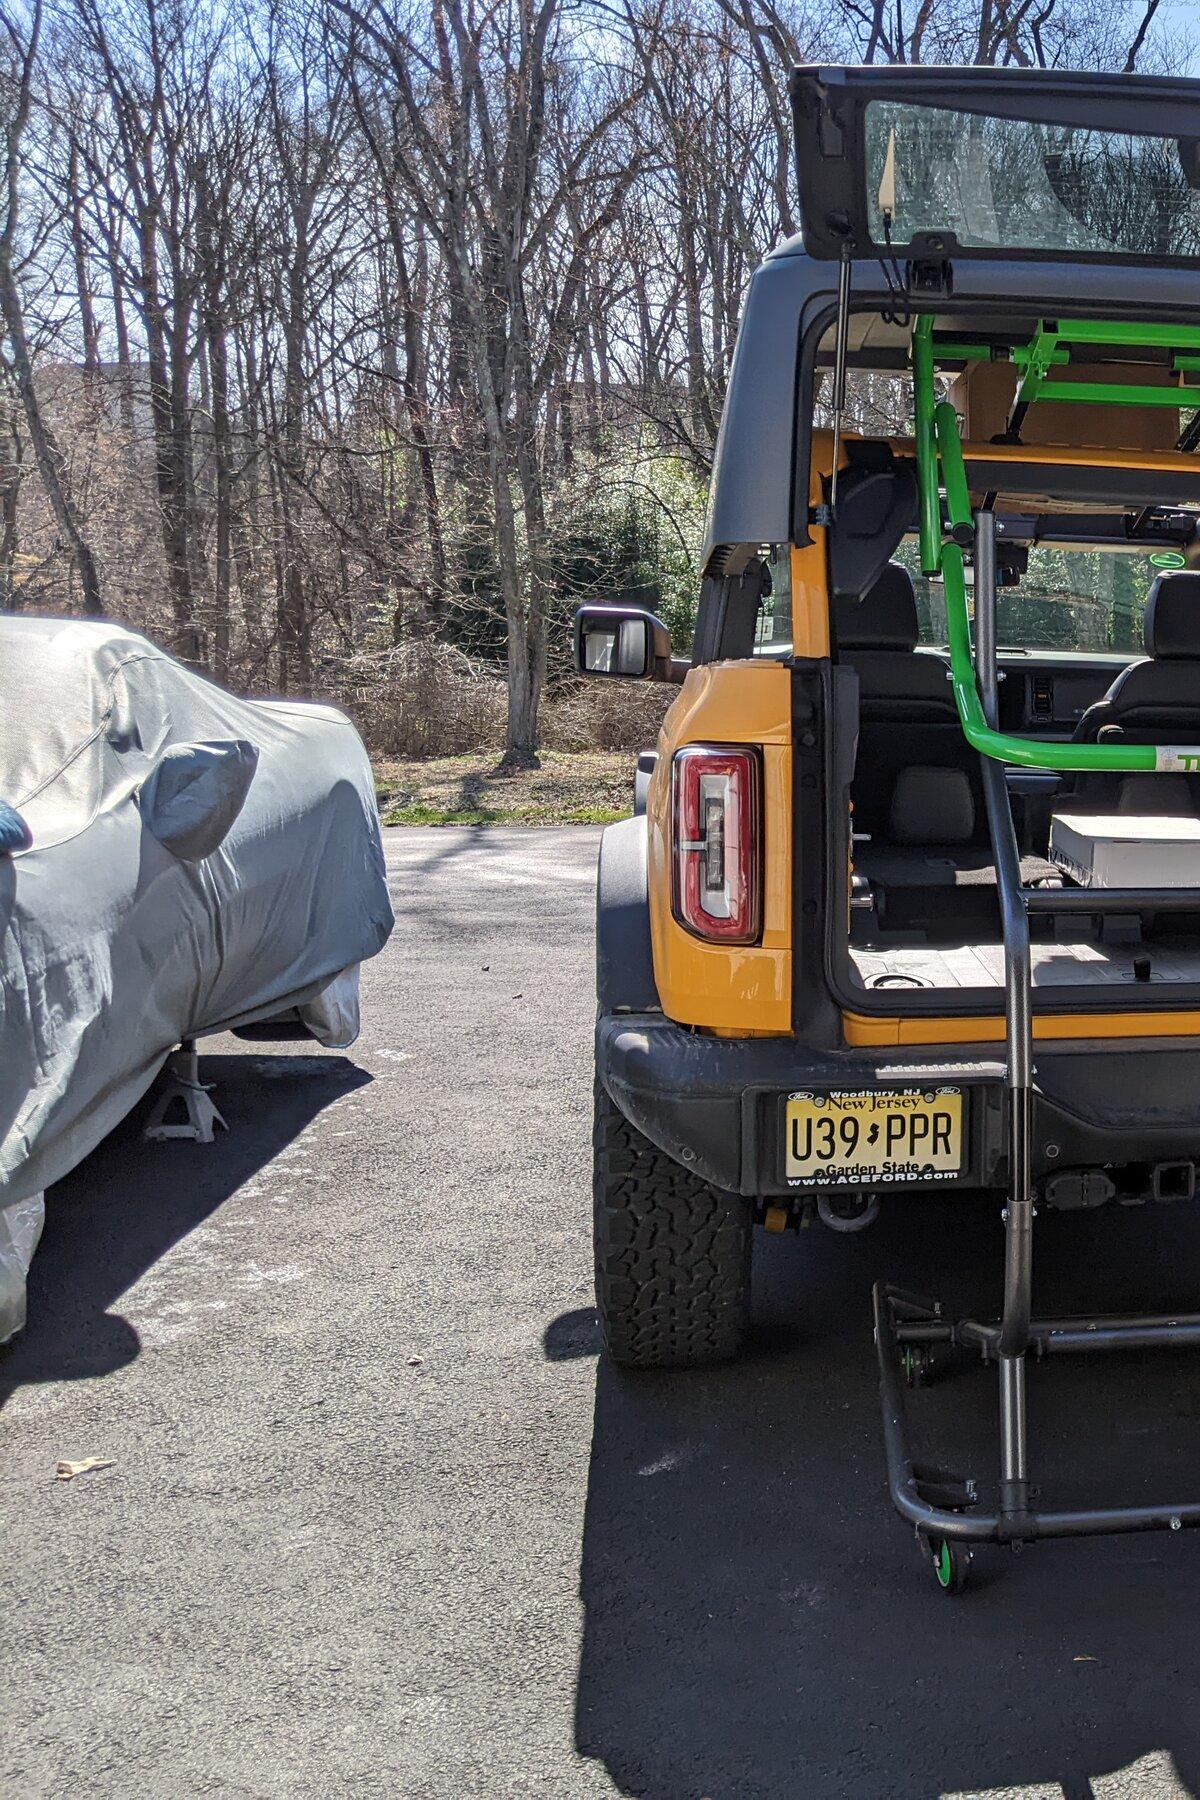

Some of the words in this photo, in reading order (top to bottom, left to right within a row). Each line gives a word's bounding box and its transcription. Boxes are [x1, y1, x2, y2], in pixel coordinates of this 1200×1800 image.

[827, 1098, 867, 1111] New
[869, 1096, 921, 1112] Jersey
[791, 1116, 860, 1161] U39
[886, 1112, 952, 1157] PPR
[826, 1164, 877, 1175] Garden
[882, 1161, 919, 1173] State
[787, 1171, 958, 1186] www.ACEFORD.com
